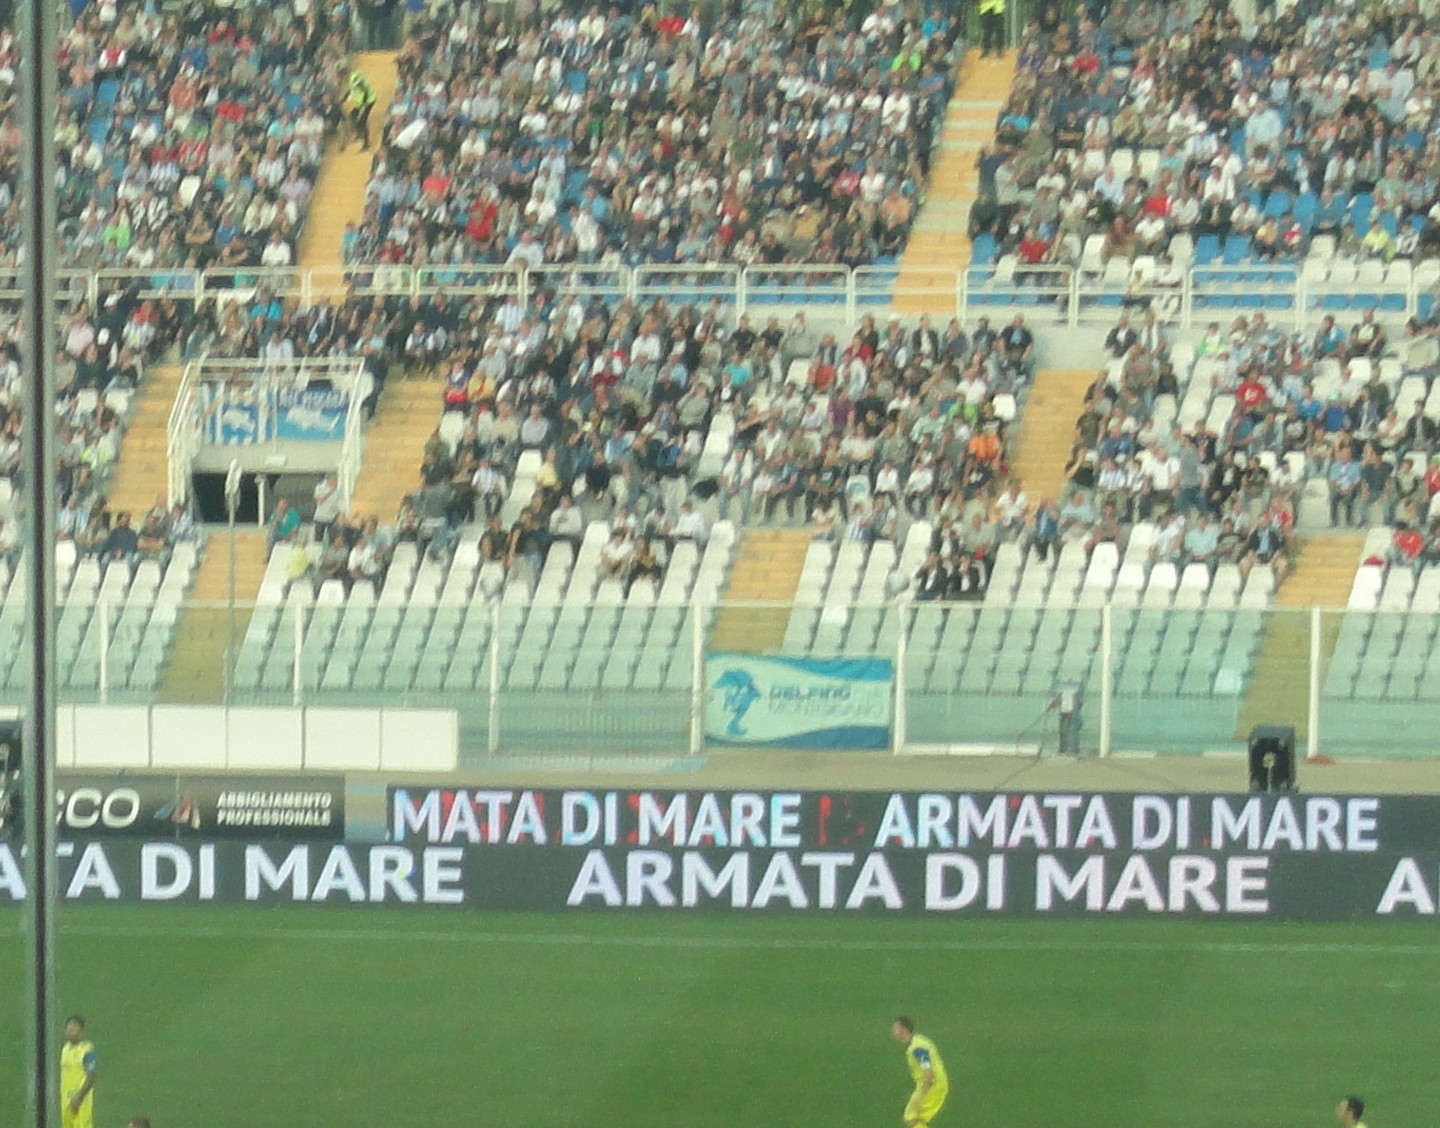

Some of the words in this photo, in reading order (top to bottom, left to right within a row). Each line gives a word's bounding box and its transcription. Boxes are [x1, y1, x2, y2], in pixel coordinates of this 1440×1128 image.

[384, 790, 548, 845] MATA
[561, 790, 618, 847] DI
[638, 791, 802, 848] MARE
[873, 793, 1117, 849] ARMATA
[1131, 795, 1191, 851] DI
[1210, 796, 1379, 852] MARE
[140, 842, 216, 900] DI
[244, 841, 465, 904] MARE
[566, 848, 903, 909] ARMATA
[924, 852, 1006, 911] DI
[1035, 853, 1270, 913] MARE
[1376, 857, 1440, 915] A
